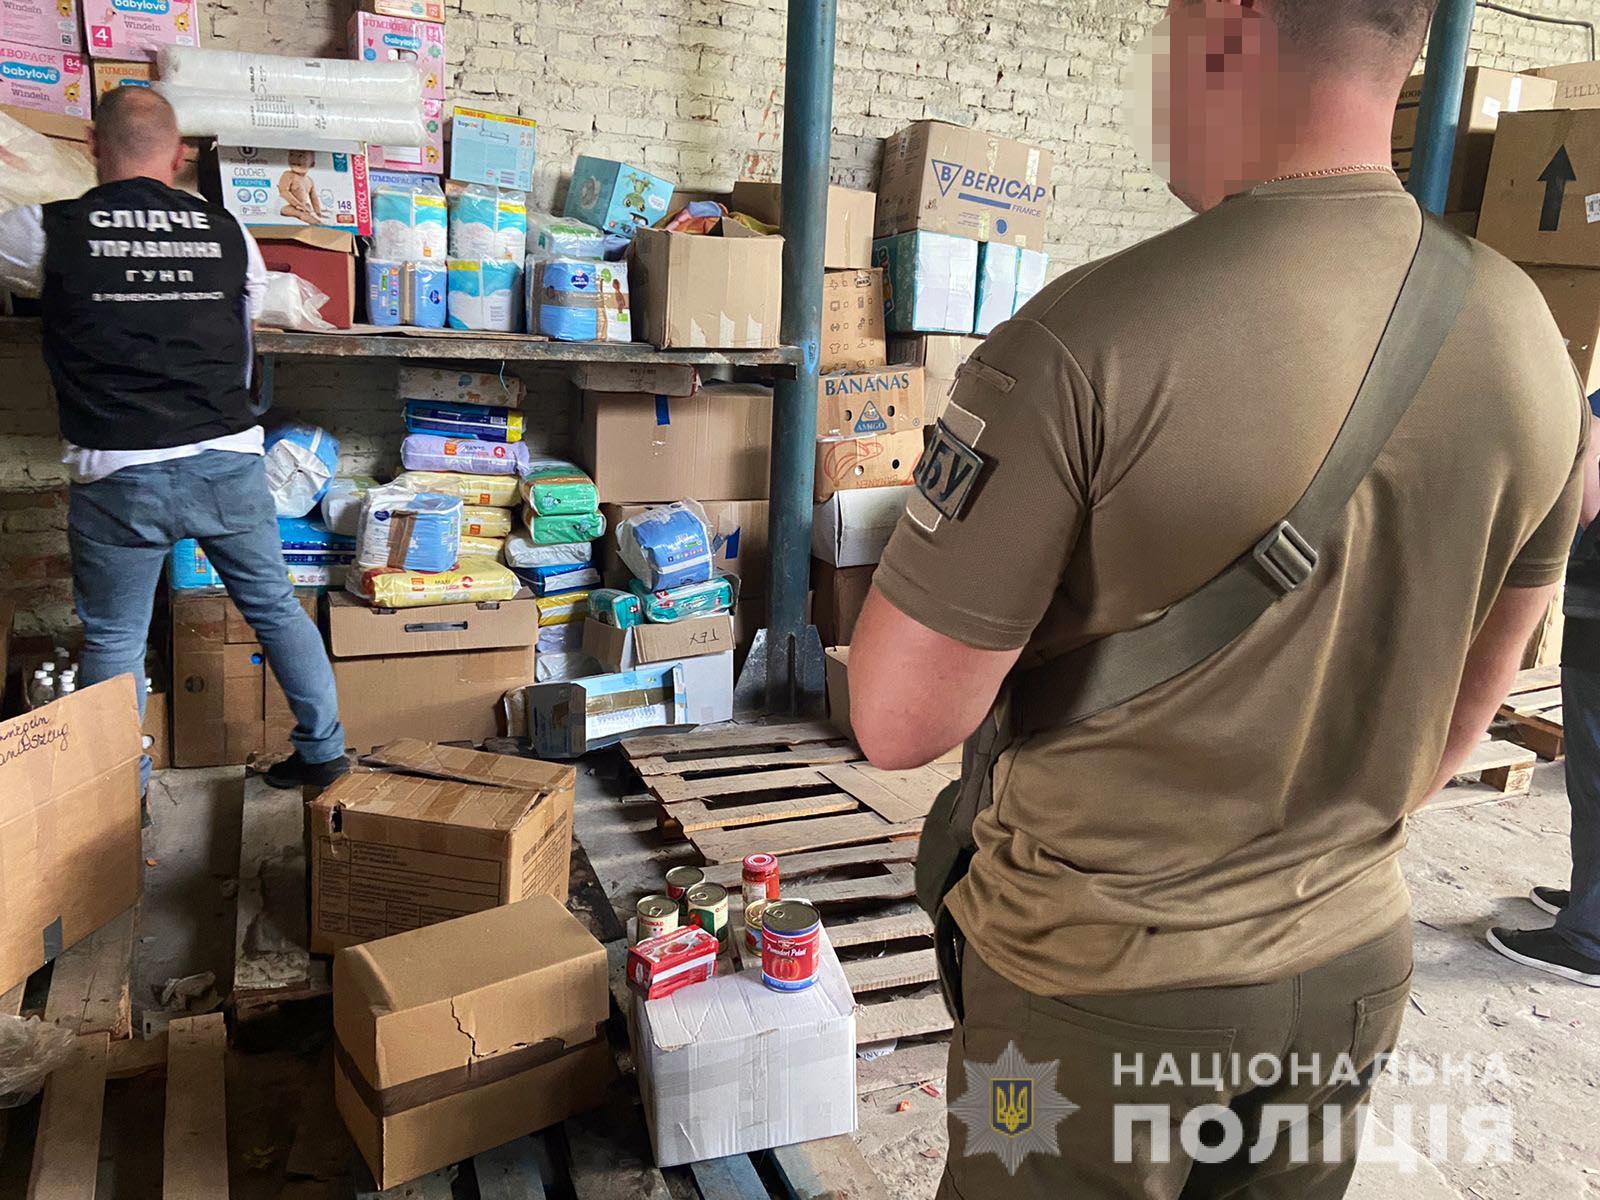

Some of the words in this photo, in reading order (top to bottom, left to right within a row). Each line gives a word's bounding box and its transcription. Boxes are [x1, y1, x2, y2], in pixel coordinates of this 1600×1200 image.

[95, 28, 109, 42] 4
[66, 58, 81, 68] 84
[2, 65, 57, 81] babylove
[11, 88, 50, 101] Windeln
[234, 167, 266, 177] COUCHES
[941, 166, 951, 181] B
[962, 169, 1046, 203] BERICAP
[337, 200, 352, 210] 148
[1011, 204, 1041, 217] FRANCE
[89, 210, 211, 232] СЛІДЧЕ
[88, 240, 222, 258] УПРАВЛІННЯ
[825, 373, 909, 396] BANANAS
